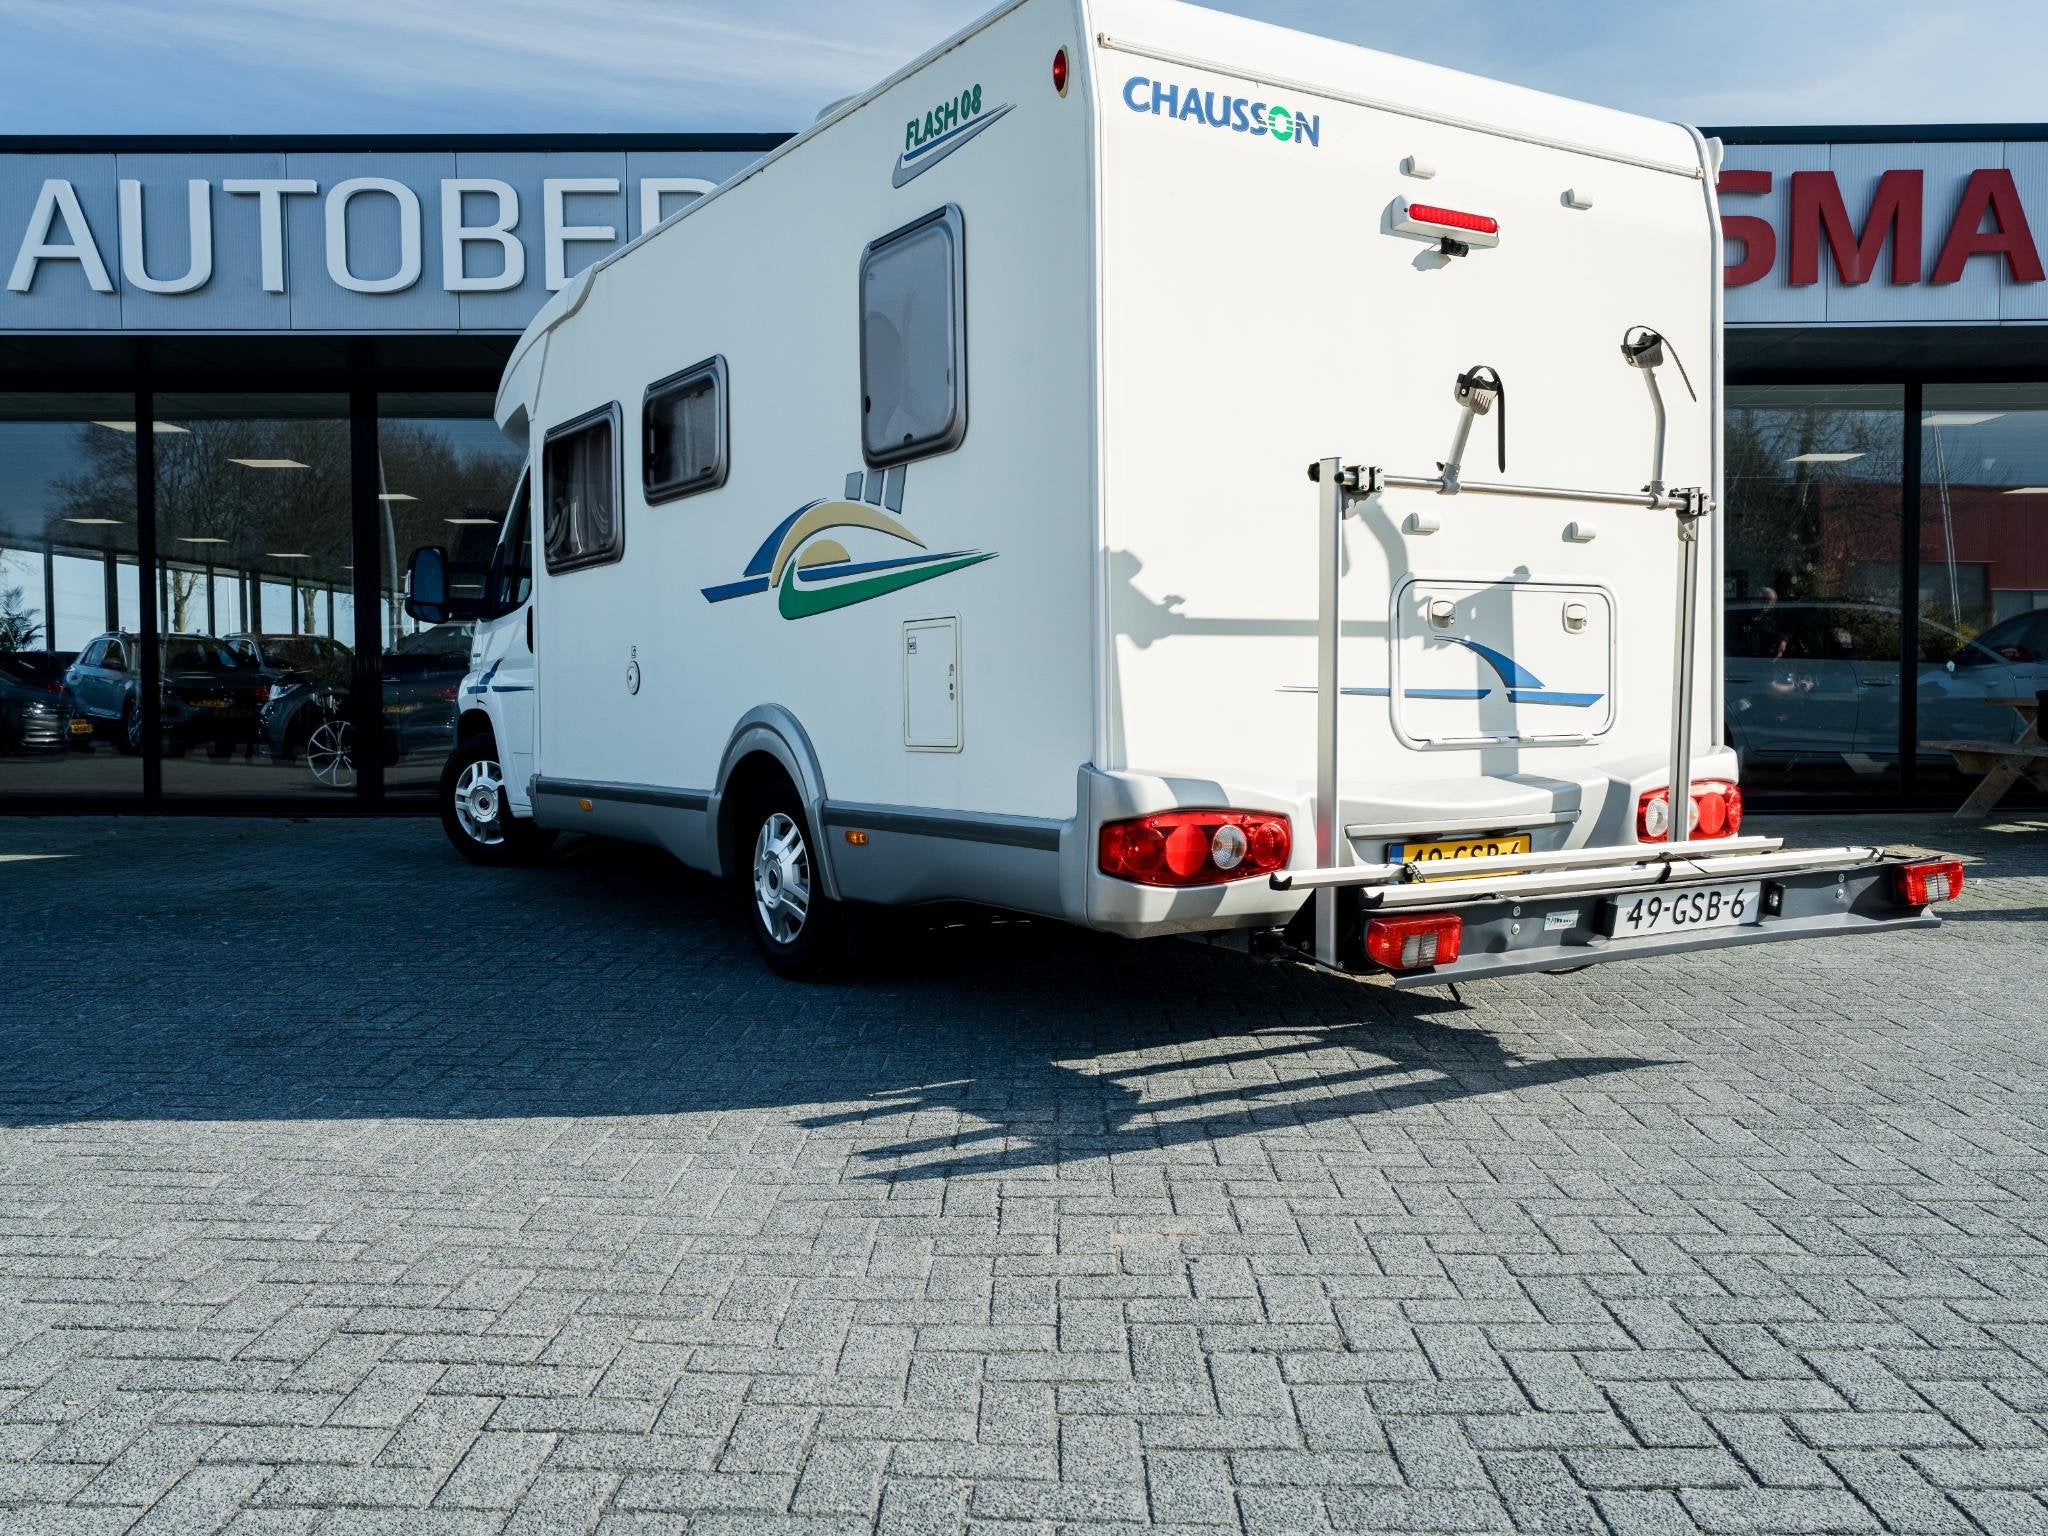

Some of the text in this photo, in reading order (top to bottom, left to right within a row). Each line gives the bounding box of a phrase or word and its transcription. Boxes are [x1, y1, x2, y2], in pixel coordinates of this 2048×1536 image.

[905, 83, 982, 151] FLASH 08
[1122, 76, 1320, 148] CHAUSSON
[1626, 888, 1745, 930] 49-GSB-6
